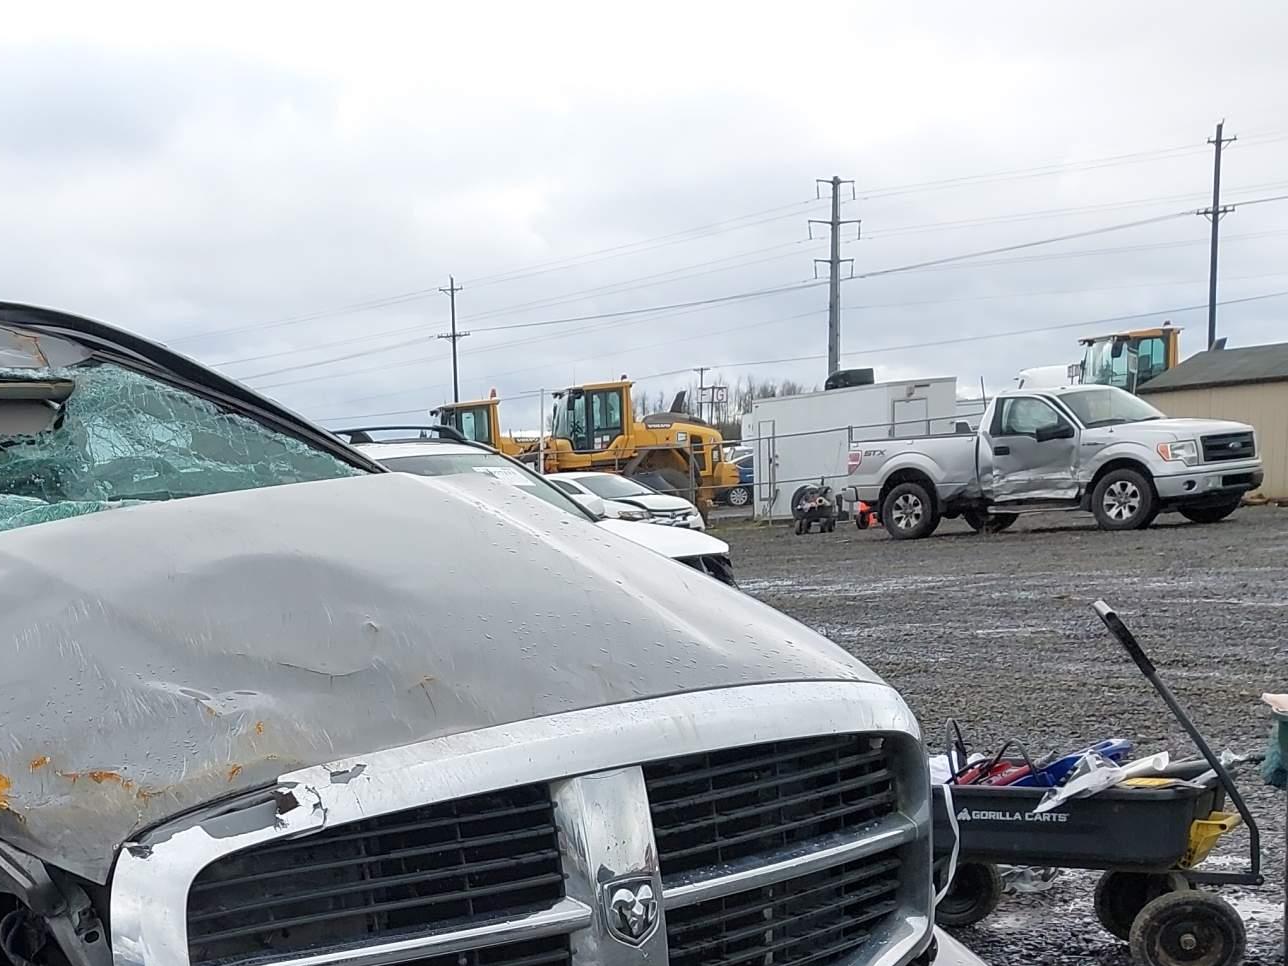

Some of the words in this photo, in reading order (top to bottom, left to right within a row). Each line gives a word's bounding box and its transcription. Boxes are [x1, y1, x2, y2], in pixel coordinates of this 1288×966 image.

[864, 449, 886, 457] STX
[971, 810, 1022, 821] GORILLA
[1024, 812, 1067, 822] CARTS
